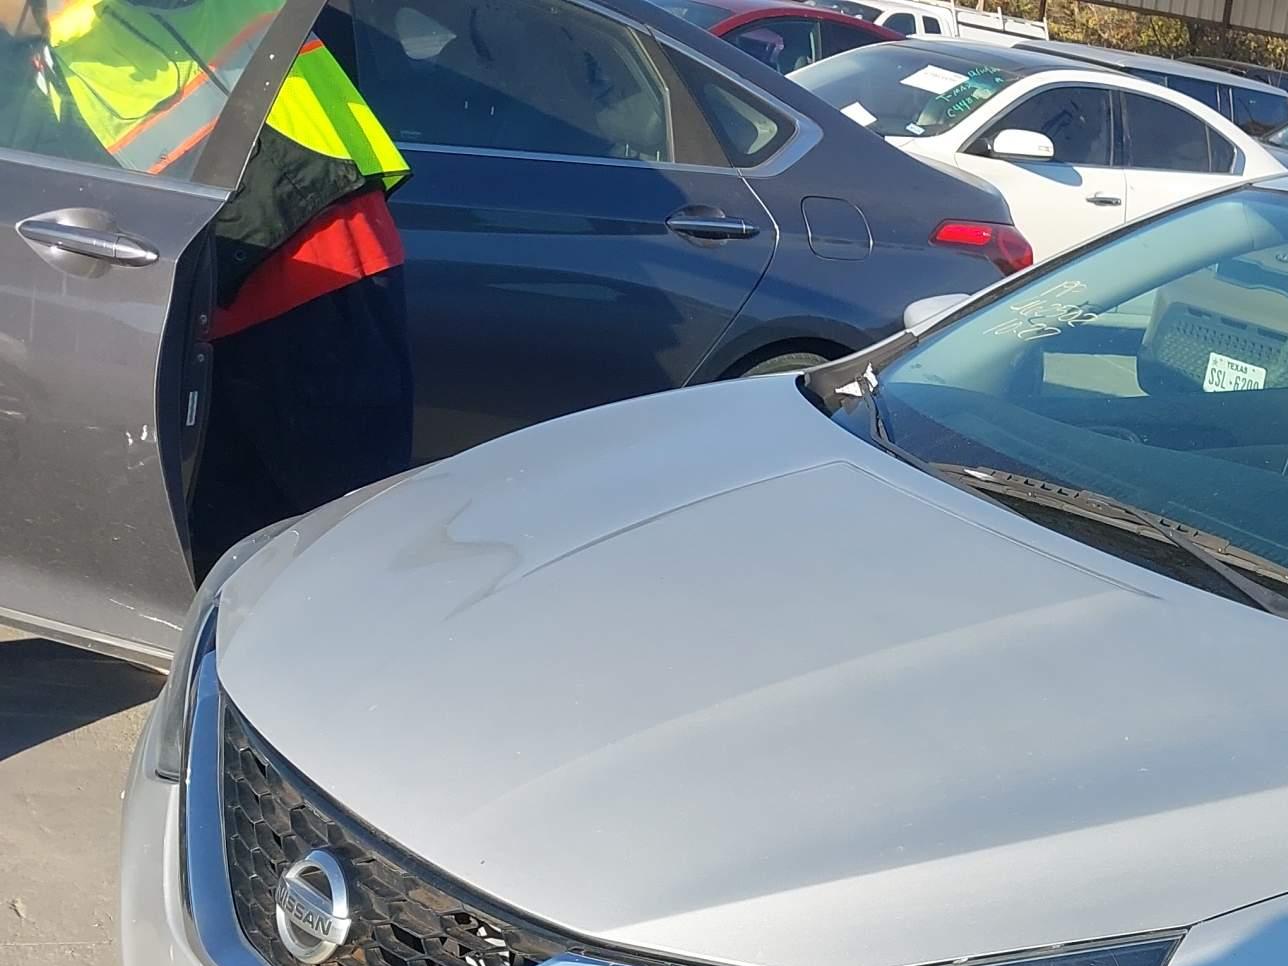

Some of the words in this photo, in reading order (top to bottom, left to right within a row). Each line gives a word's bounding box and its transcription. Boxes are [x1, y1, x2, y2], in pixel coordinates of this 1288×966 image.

[1208, 367, 1227, 390] SSL
[1227, 361, 1248, 374] TEXAS
[276, 884, 333, 937] NISSAN
